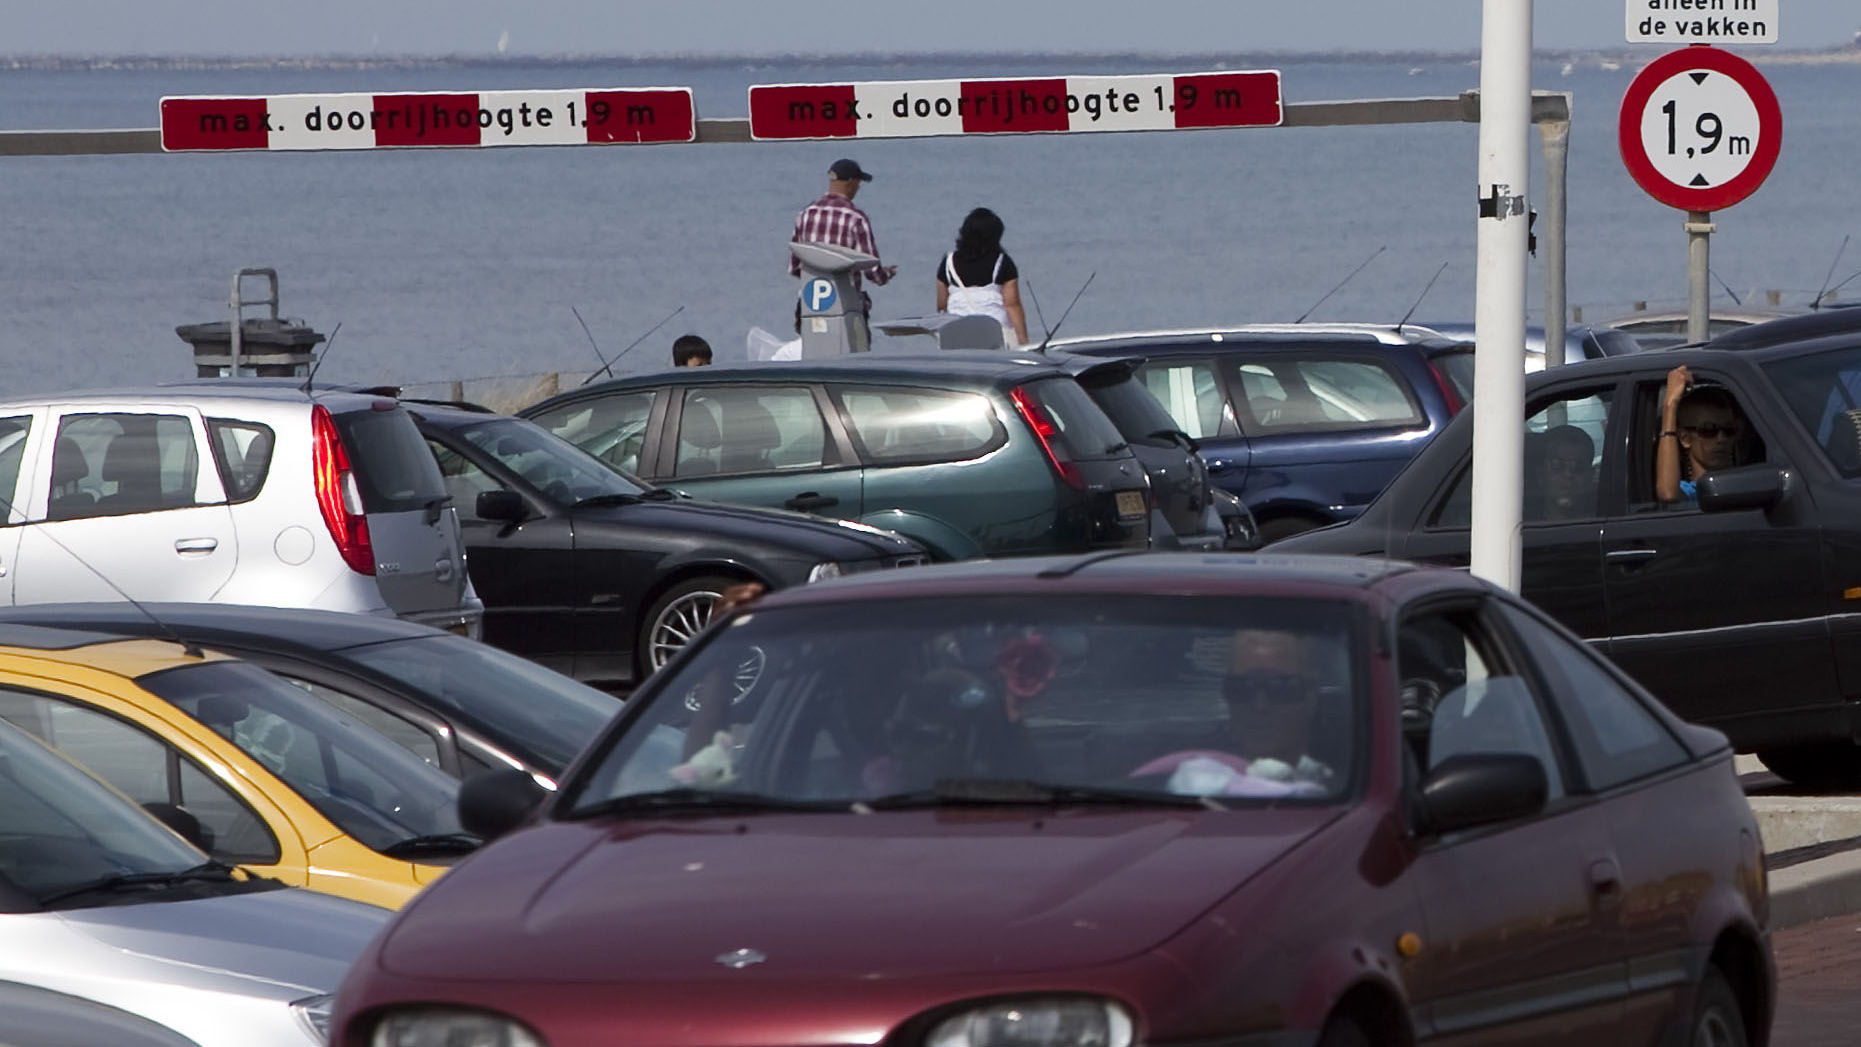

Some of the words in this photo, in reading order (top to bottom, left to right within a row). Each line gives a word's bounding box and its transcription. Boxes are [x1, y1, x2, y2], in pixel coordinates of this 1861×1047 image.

[1638, 16, 1667, 36] de
[1674, 16, 1766, 36] vakken
[201, 111, 285, 133] max.
[305, 102, 553, 136] doorrijhoogte
[627, 104, 656, 125] m
[787, 99, 874, 121] max.
[892, 85, 1140, 121] doorrijhoogte
[1214, 87, 1242, 108] m
[1662, 100, 1722, 159] 1,9
[1729, 134, 1750, 155] m
[813, 279, 832, 311] P
